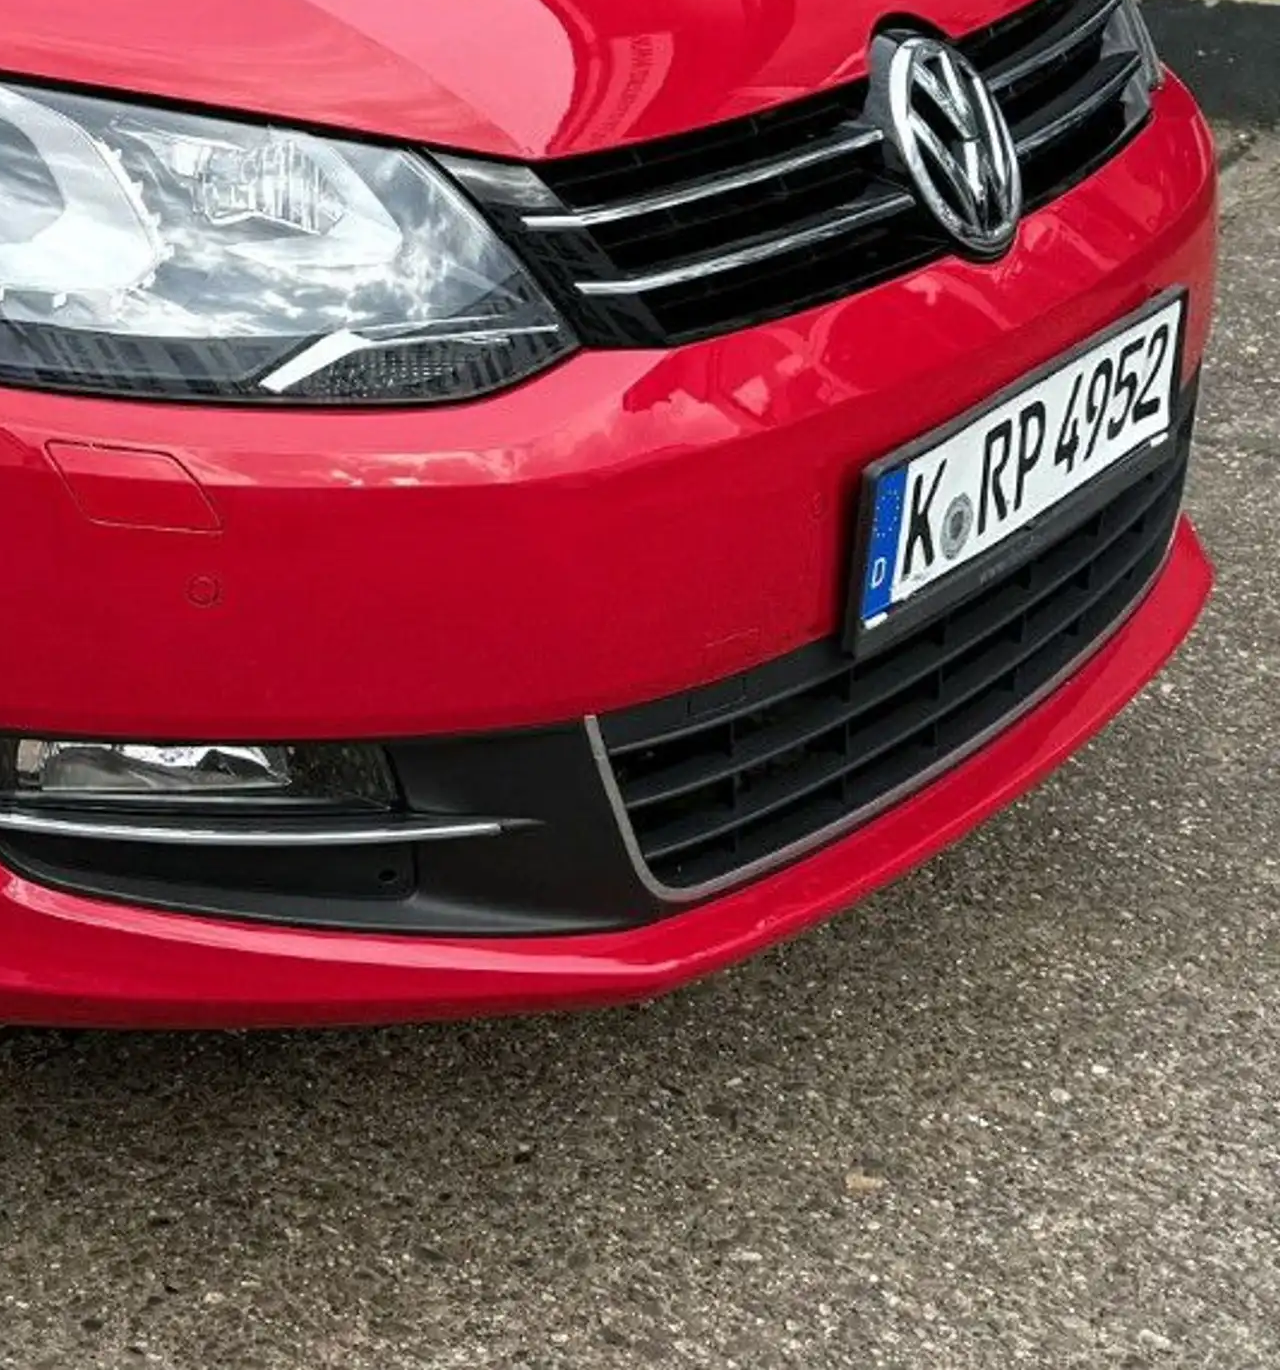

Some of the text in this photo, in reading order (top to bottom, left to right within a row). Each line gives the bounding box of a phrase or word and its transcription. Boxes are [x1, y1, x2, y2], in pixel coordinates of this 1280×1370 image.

[871, 323, 1169, 590] D K RP 4952
